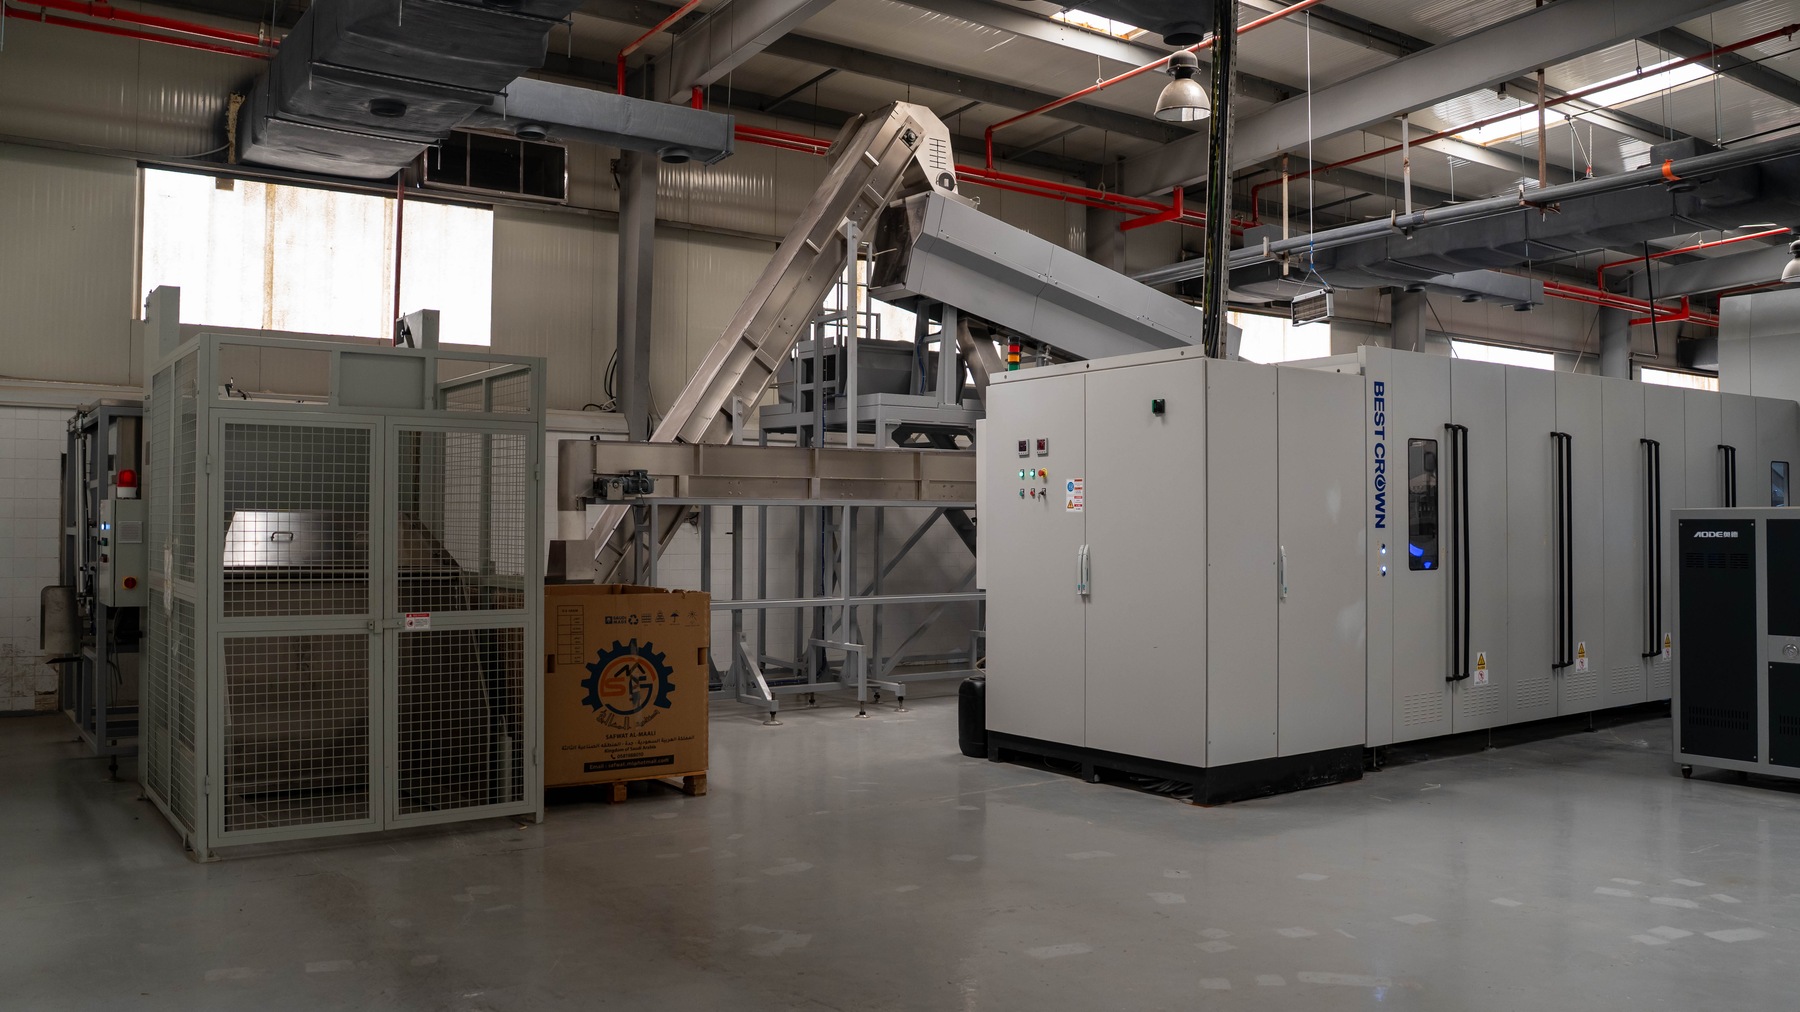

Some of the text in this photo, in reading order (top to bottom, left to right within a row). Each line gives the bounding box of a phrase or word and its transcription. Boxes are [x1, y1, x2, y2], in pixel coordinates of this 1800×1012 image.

[1373, 381, 1387, 529] BEST CROWN
[605, 730, 657, 740] SAFWAT AL-MAALI
